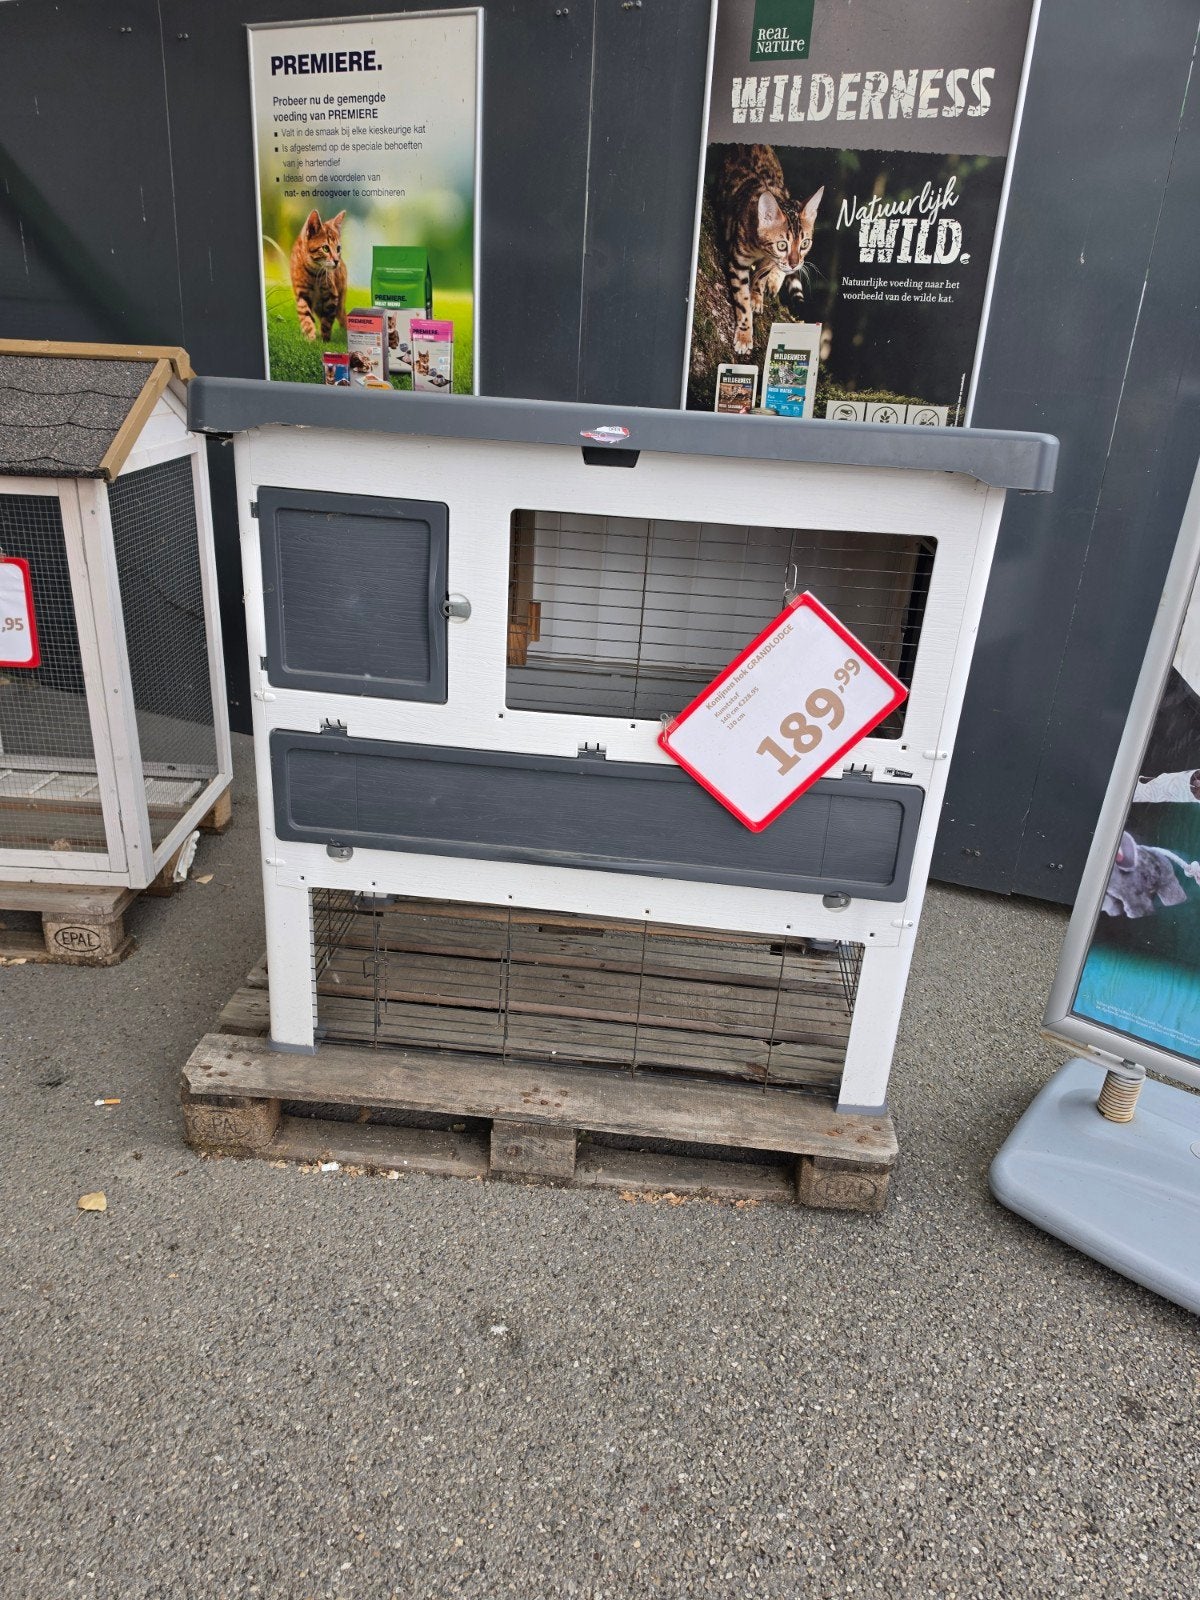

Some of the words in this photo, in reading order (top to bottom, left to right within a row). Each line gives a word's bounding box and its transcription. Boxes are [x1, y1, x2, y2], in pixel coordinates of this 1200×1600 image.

[271, 50, 382, 75] PREMIERE.
[273, 96, 307, 106] Probeer
[310, 96, 320, 105] nu
[324, 94, 334, 105] de
[337, 92, 386, 106] gemengde
[731, 68, 995, 123] WILDERNESS
[273, 111, 308, 124] voeding
[310, 112, 326, 120] van
[328, 108, 378, 120] PREMIERE
[281, 128, 294, 138] Valt
[296, 128, 303, 137] in
[304, 127, 314, 136] de
[315, 126, 339, 136] smaak
[341, 126, 350, 138] bij
[352, 126, 367, 135] elke
[368, 125, 411, 137] kieskeurige
[414, 125, 426, 134] kat
[282, 144, 288, 153] Is
[290, 143, 327, 154] afgestemd
[329, 144, 339, 154] op
[340, 142, 350, 152] de
[352, 142, 382, 153] speciale
[384, 141, 422, 150] behoeften
[296, 159, 303, 170] je
[305, 158, 340, 168] hartendief
[283, 174, 304, 183] Ideaal
[319, 173, 328, 182] de
[330, 173, 366, 182] voordelen
[367, 174, 380, 182] van
[284, 188, 299, 197] nat-
[301, 189, 310, 197] en
[312, 188, 350, 199] droogvoer
[352, 188, 360, 197] te
[361, 188, 405, 197] combineren
[836, 176, 959, 230] Natuurlijk
[859, 218, 970, 264] WILD.
[841, 277, 888, 289] Natuurlijke
[890, 280, 922, 290] voeding
[945, 280, 960, 289] het
[843, 291, 883, 300] voorbeeld
[902, 292, 912, 302] de
[914, 293, 936, 302] wilde
[938, 293, 954, 303] kat.
[706, 682, 736, 710] Konijnen
[733, 668, 748, 685] hok
[747, 624, 794, 671] GRANDLODGE
[714, 691, 740, 718] Kunststof
[731, 706, 740, 716] cm
[737, 713, 746, 722] cm
[62, 932, 96, 947] EPAL
